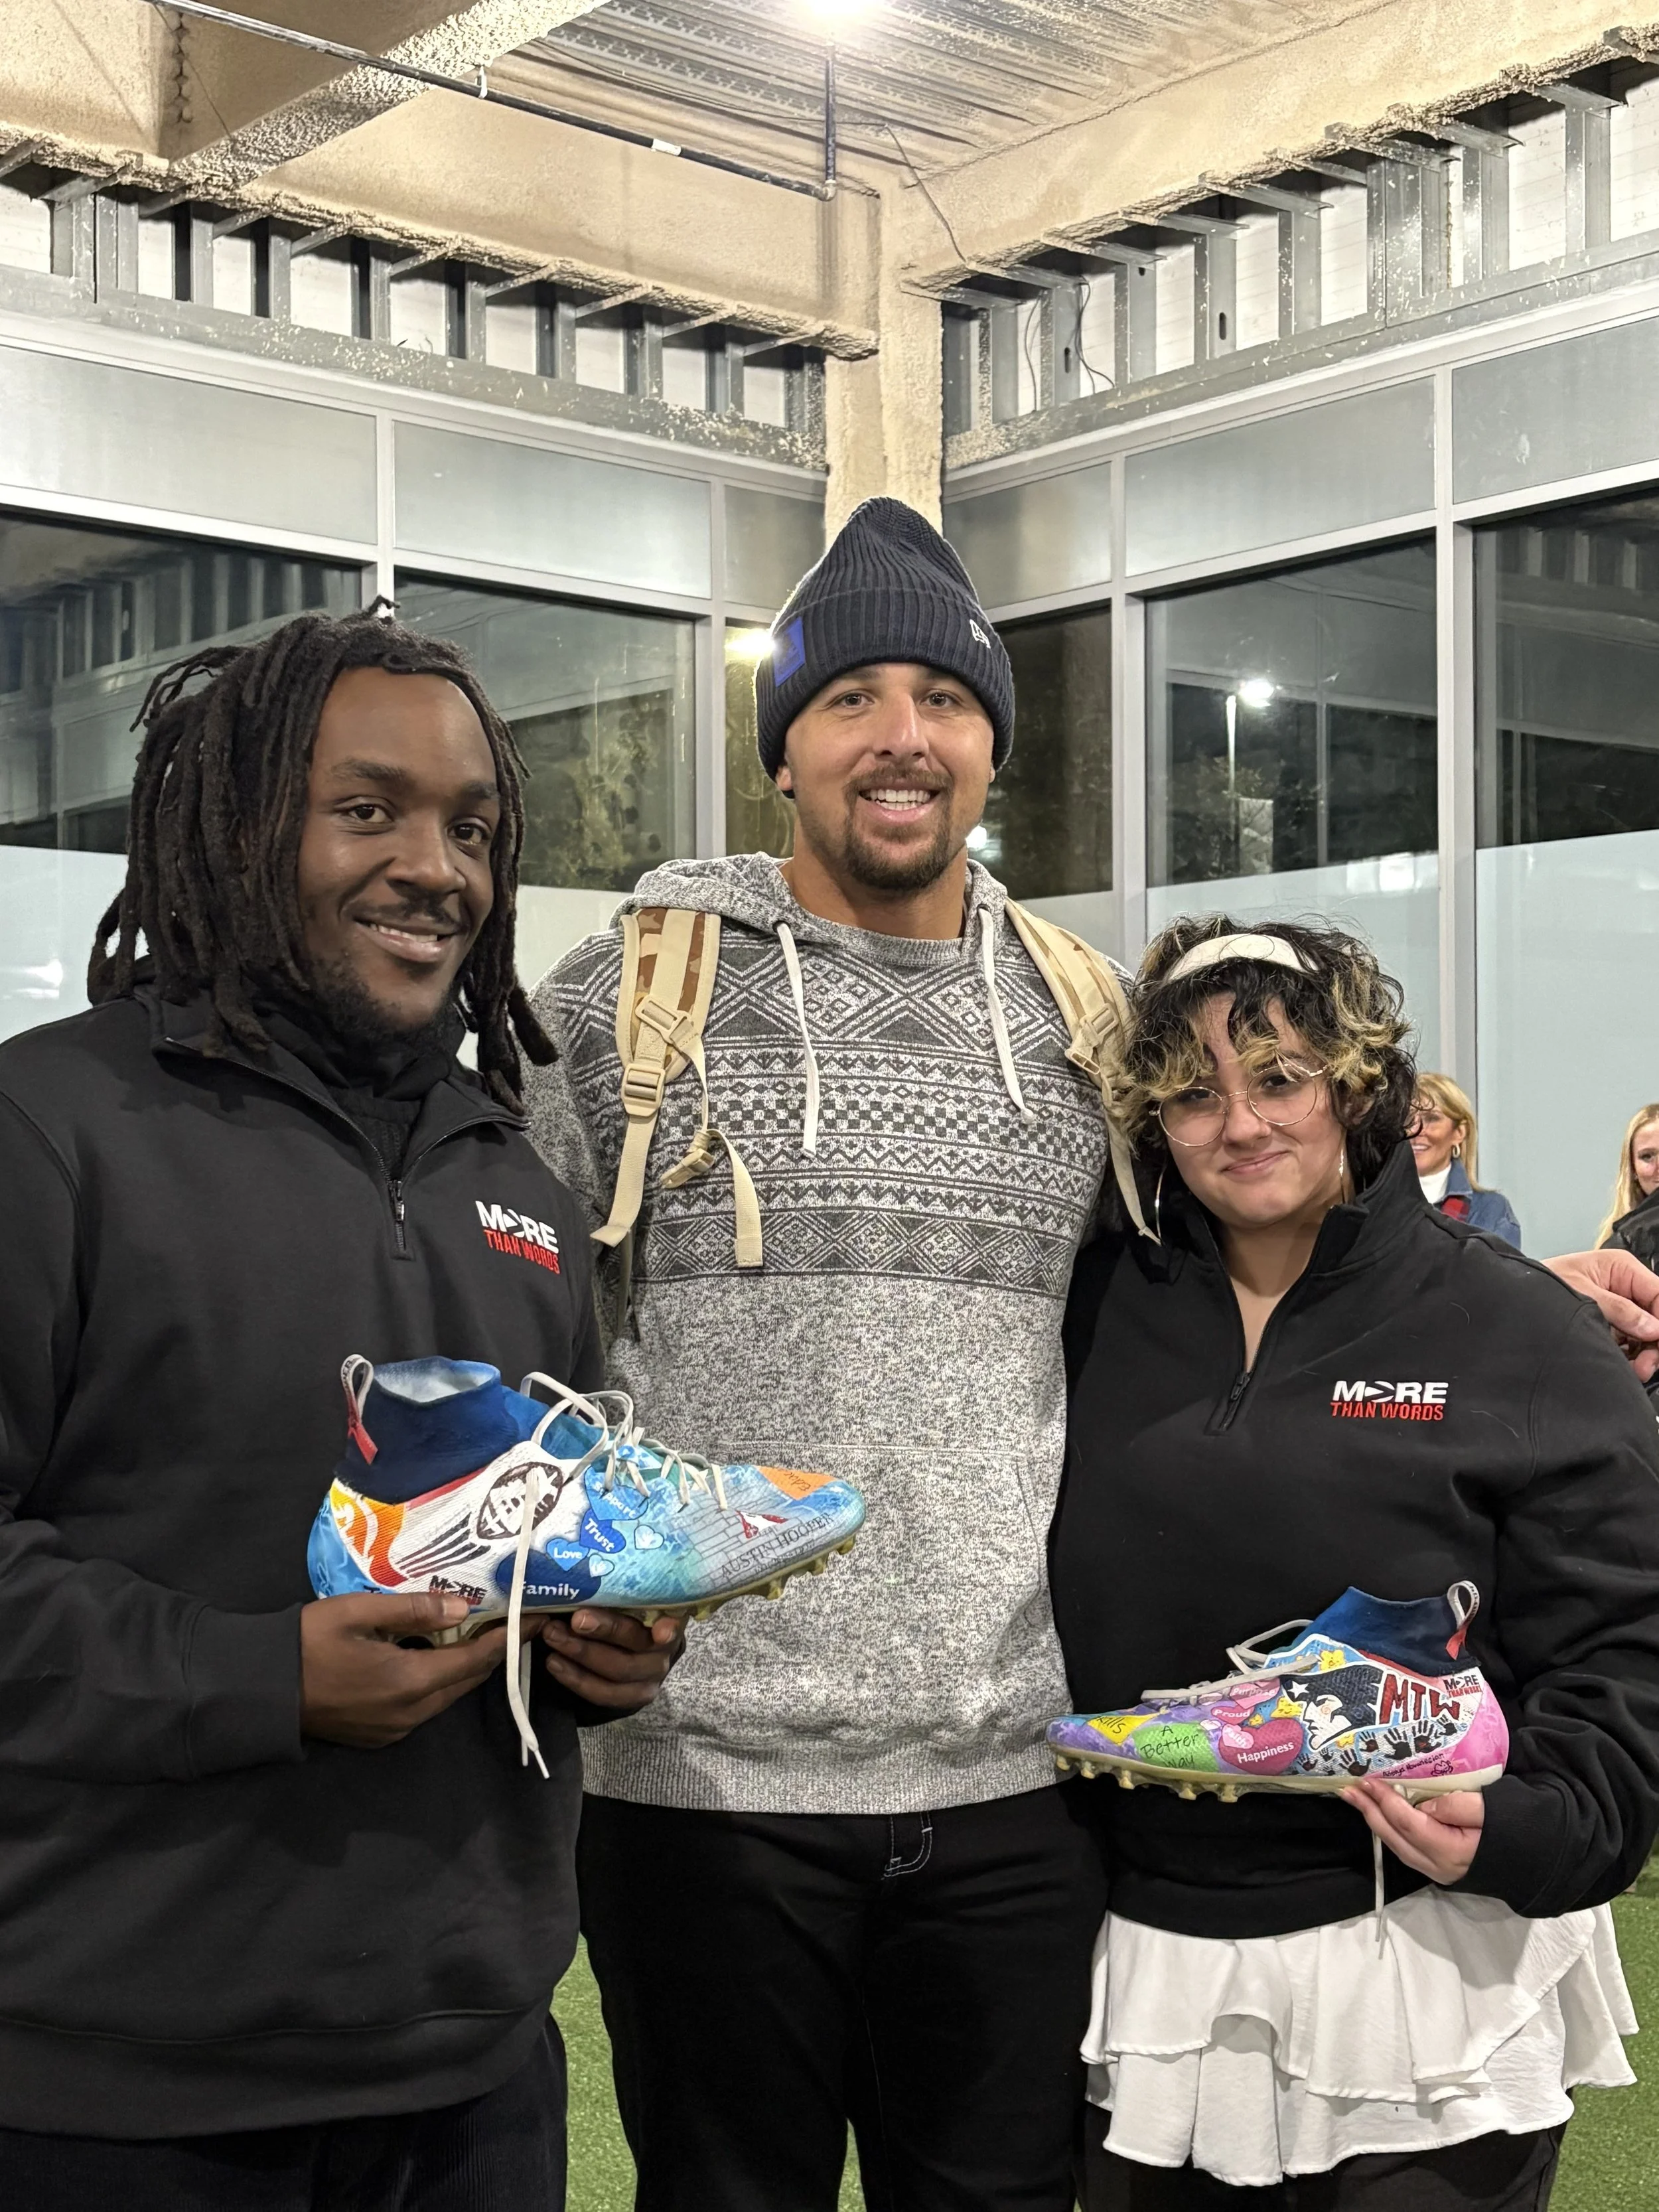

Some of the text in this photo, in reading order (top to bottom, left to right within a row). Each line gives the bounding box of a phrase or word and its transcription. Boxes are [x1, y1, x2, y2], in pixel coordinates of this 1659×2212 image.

[475, 1200, 559, 1254] MORE
[483, 1229, 561, 1275] THAN WORDS
[1333, 1380, 1449, 1404] MORE
[1330, 1402, 1444, 1421] THAN WORDS
[585, 1518, 615, 1552] Trust
[553, 1547, 583, 1559] Love
[1379, 1674, 1461, 1725] MTW
[1214, 1709, 1251, 1718] Proud
[1161, 1726, 1174, 1737] A
[1140, 1733, 1199, 1759] Better
[1237, 1741, 1295, 1763] Happiness
